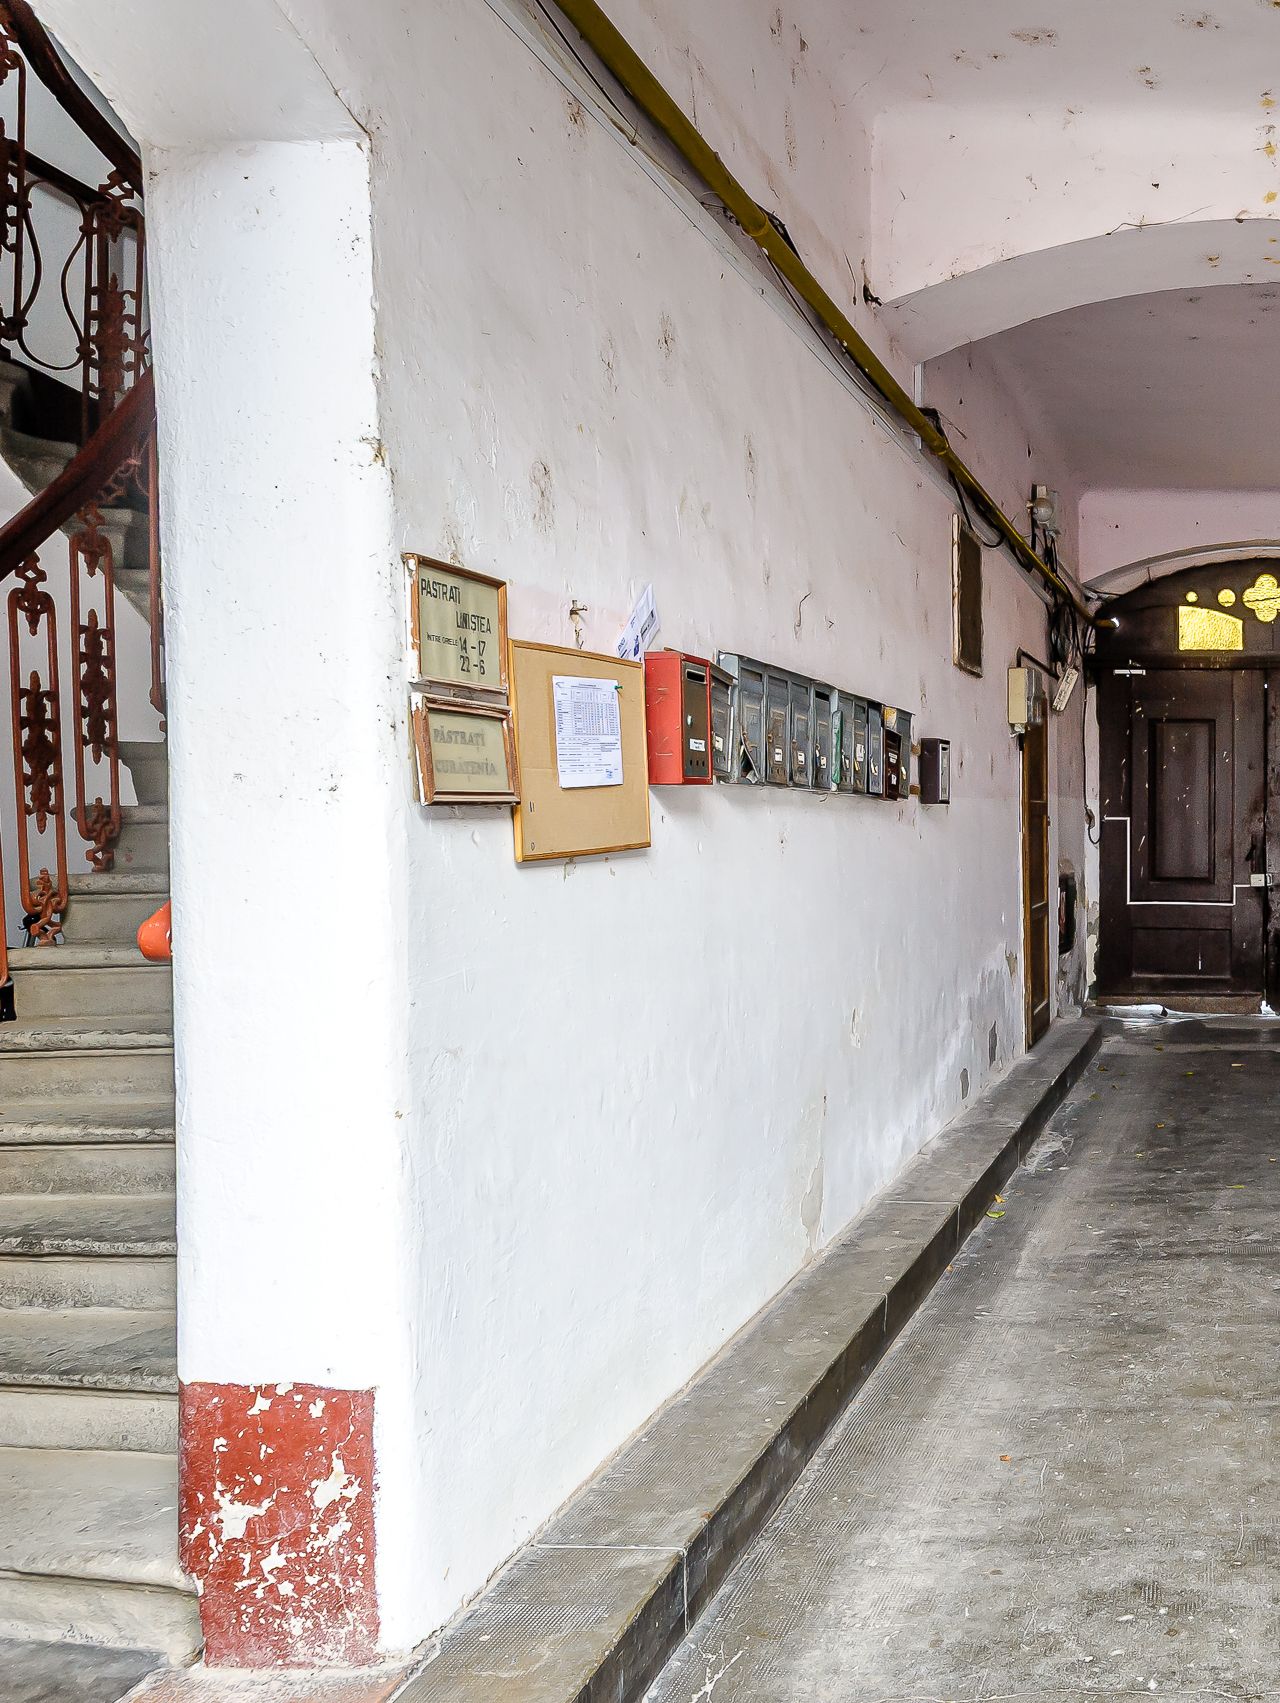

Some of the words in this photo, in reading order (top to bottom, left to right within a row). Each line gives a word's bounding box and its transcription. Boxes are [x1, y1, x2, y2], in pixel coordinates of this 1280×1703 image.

[459, 636, 468, 654] 14
[478, 640, 486, 657] 17
[460, 655, 470, 672] 22
[479, 659, 486, 675] 6
